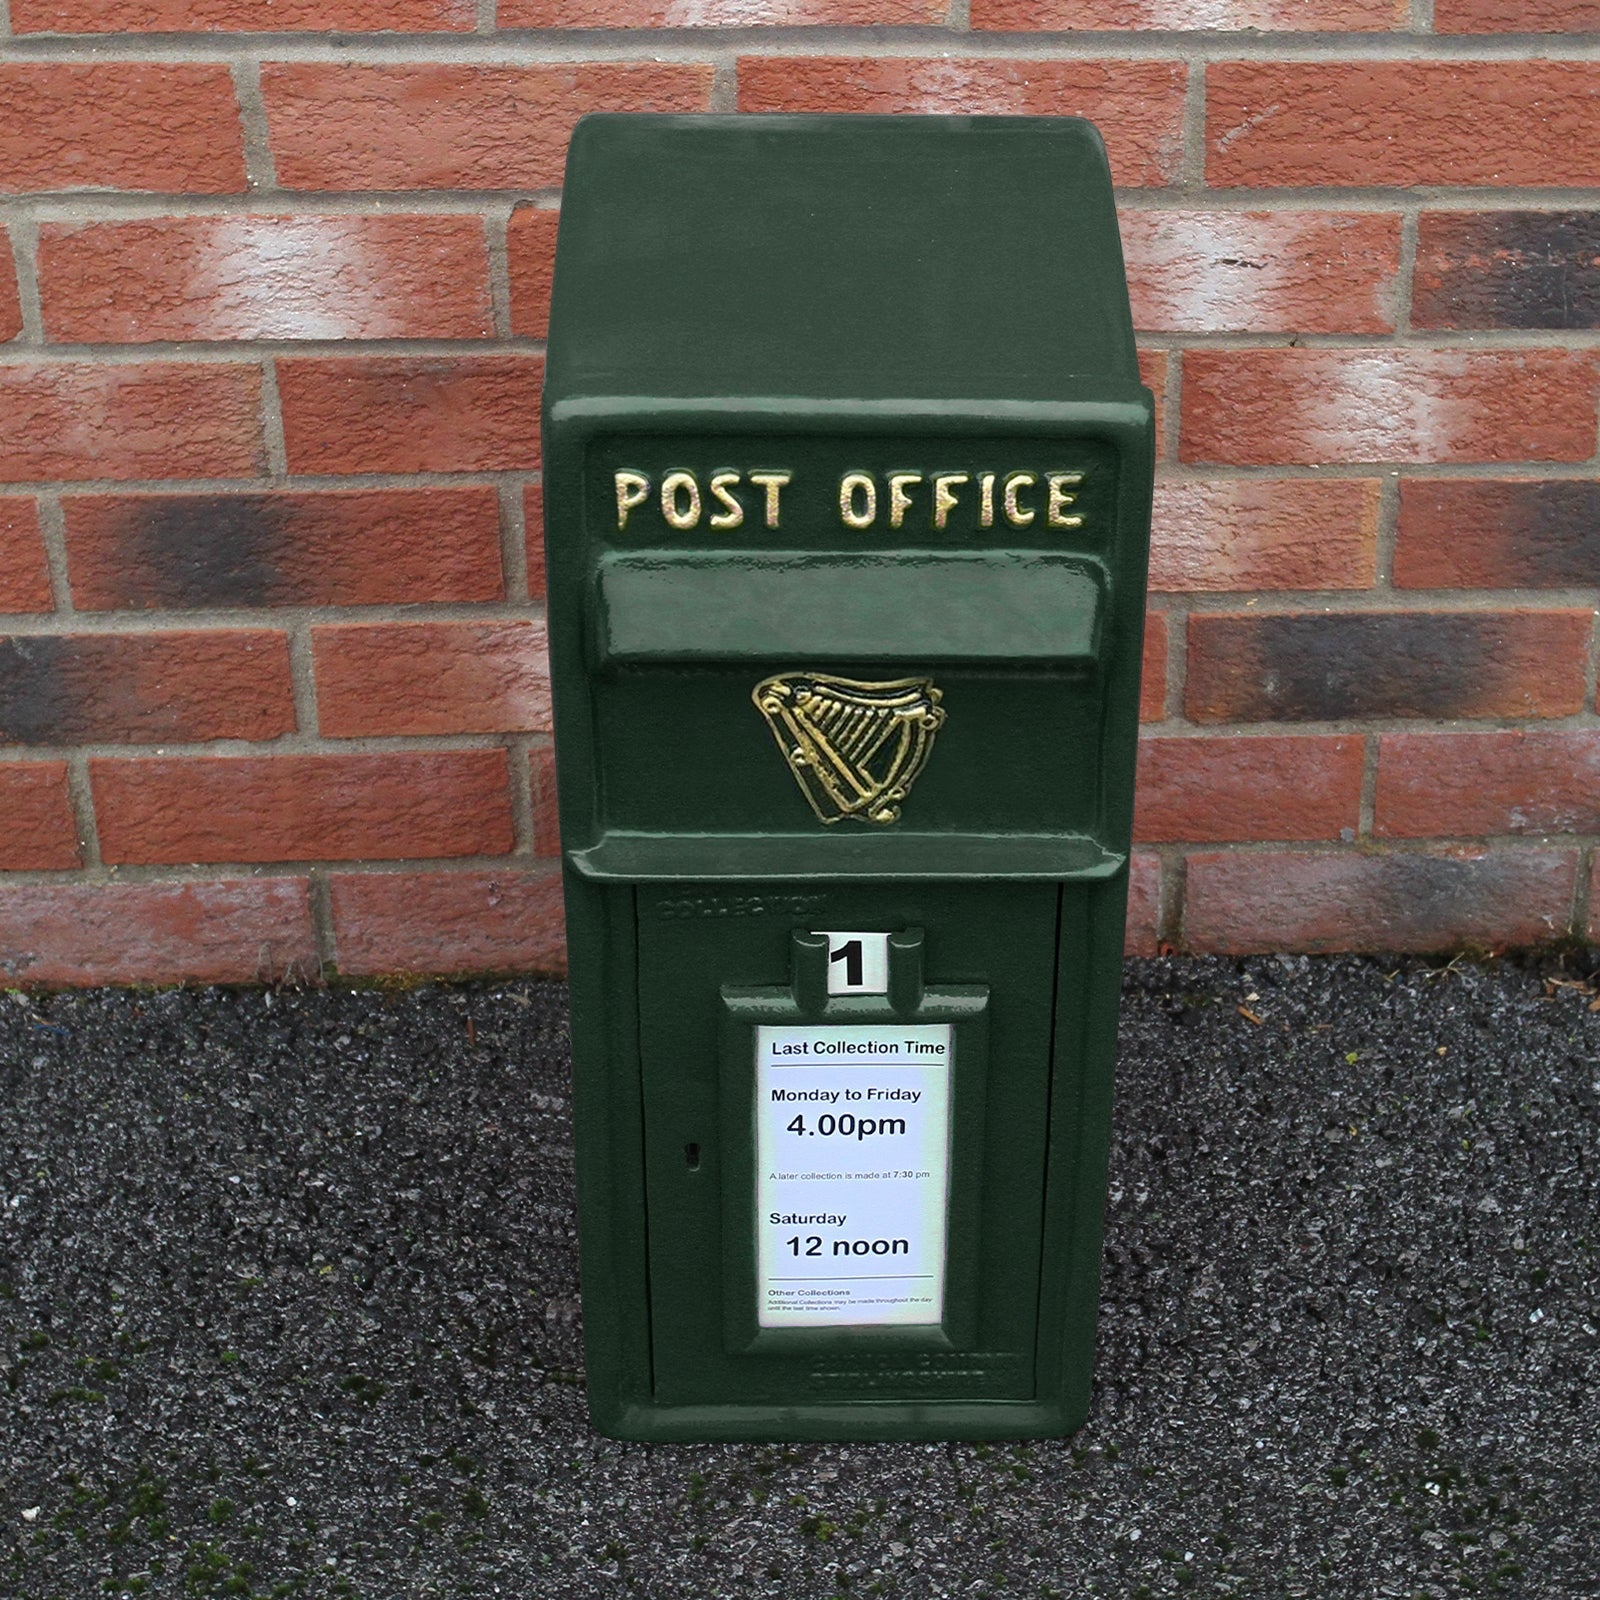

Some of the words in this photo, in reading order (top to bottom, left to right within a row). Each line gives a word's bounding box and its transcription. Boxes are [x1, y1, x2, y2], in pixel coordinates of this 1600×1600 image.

[614, 471, 791, 530] POST
[839, 471, 1084, 529] OFFICE
[830, 940, 864, 986] 1
[772, 1041, 809, 1056] Last
[813, 1040, 899, 1055] Collection
[903, 1040, 946, 1055] Time
[771, 1088, 840, 1105] Monday
[844, 1088, 862, 1102] to
[867, 1087, 922, 1104] Friday
[786, 1113, 907, 1141] 4.00pm
[769, 1172, 777, 1180] A
[778, 1172, 799, 1180] later
[800, 1172, 843, 1180] collection
[844, 1172, 853, 1180] is
[882, 1171, 891, 1179] at
[893, 1170, 914, 1179] 7:30
[915, 1171, 930, 1180] pm
[769, 1211, 847, 1229] Saturday
[786, 1236, 823, 1257] 12
[832, 1237, 910, 1257] noon
[767, 1289, 796, 1297] Other
